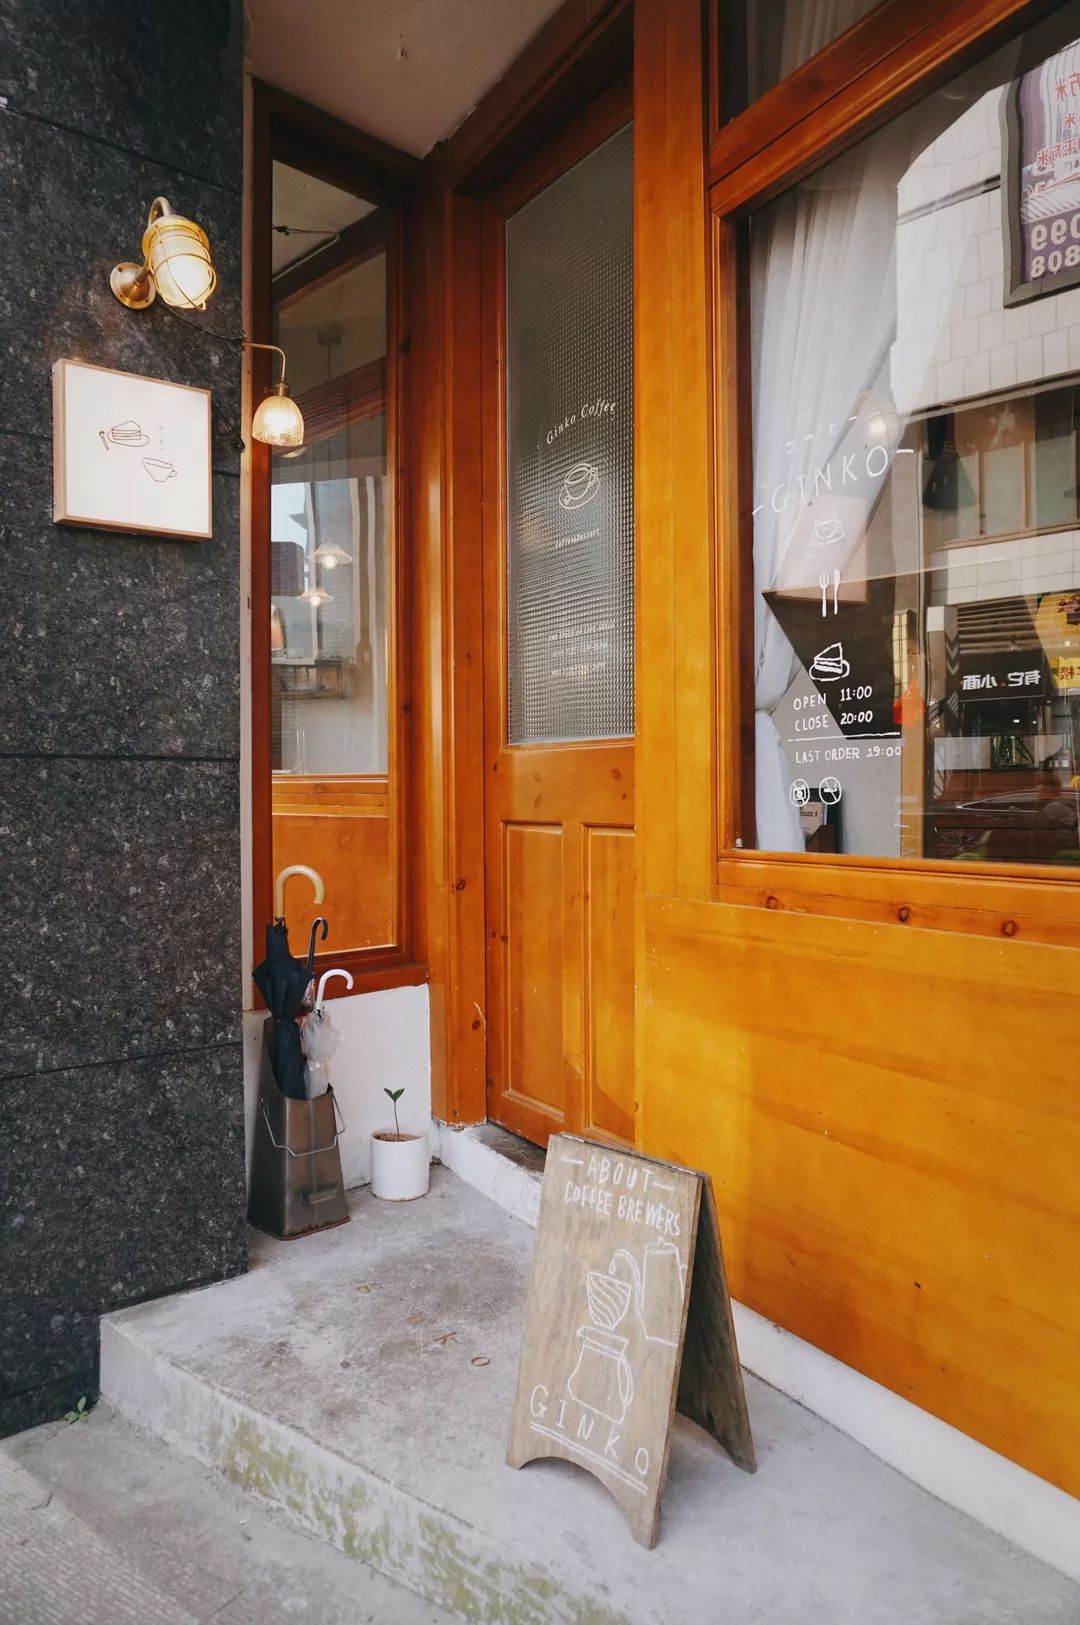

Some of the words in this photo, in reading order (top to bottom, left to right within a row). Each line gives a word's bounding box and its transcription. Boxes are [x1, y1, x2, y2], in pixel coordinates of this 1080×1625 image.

[546, 414, 576, 446] Ginko
[580, 398, 618, 420] Coffee
[793, 693, 828, 711] OPEN
[840, 685, 872, 702] 11:00
[794, 714, 829, 732] CLOSE
[840, 710, 873, 725] 20:00
[795, 750, 820, 764] LAST
[825, 747, 860, 762] ORDER
[866, 746, 902, 758] 19:00
[617, 1195, 681, 1237] BREWERS
[530, 1384, 649, 1475] GINKO
